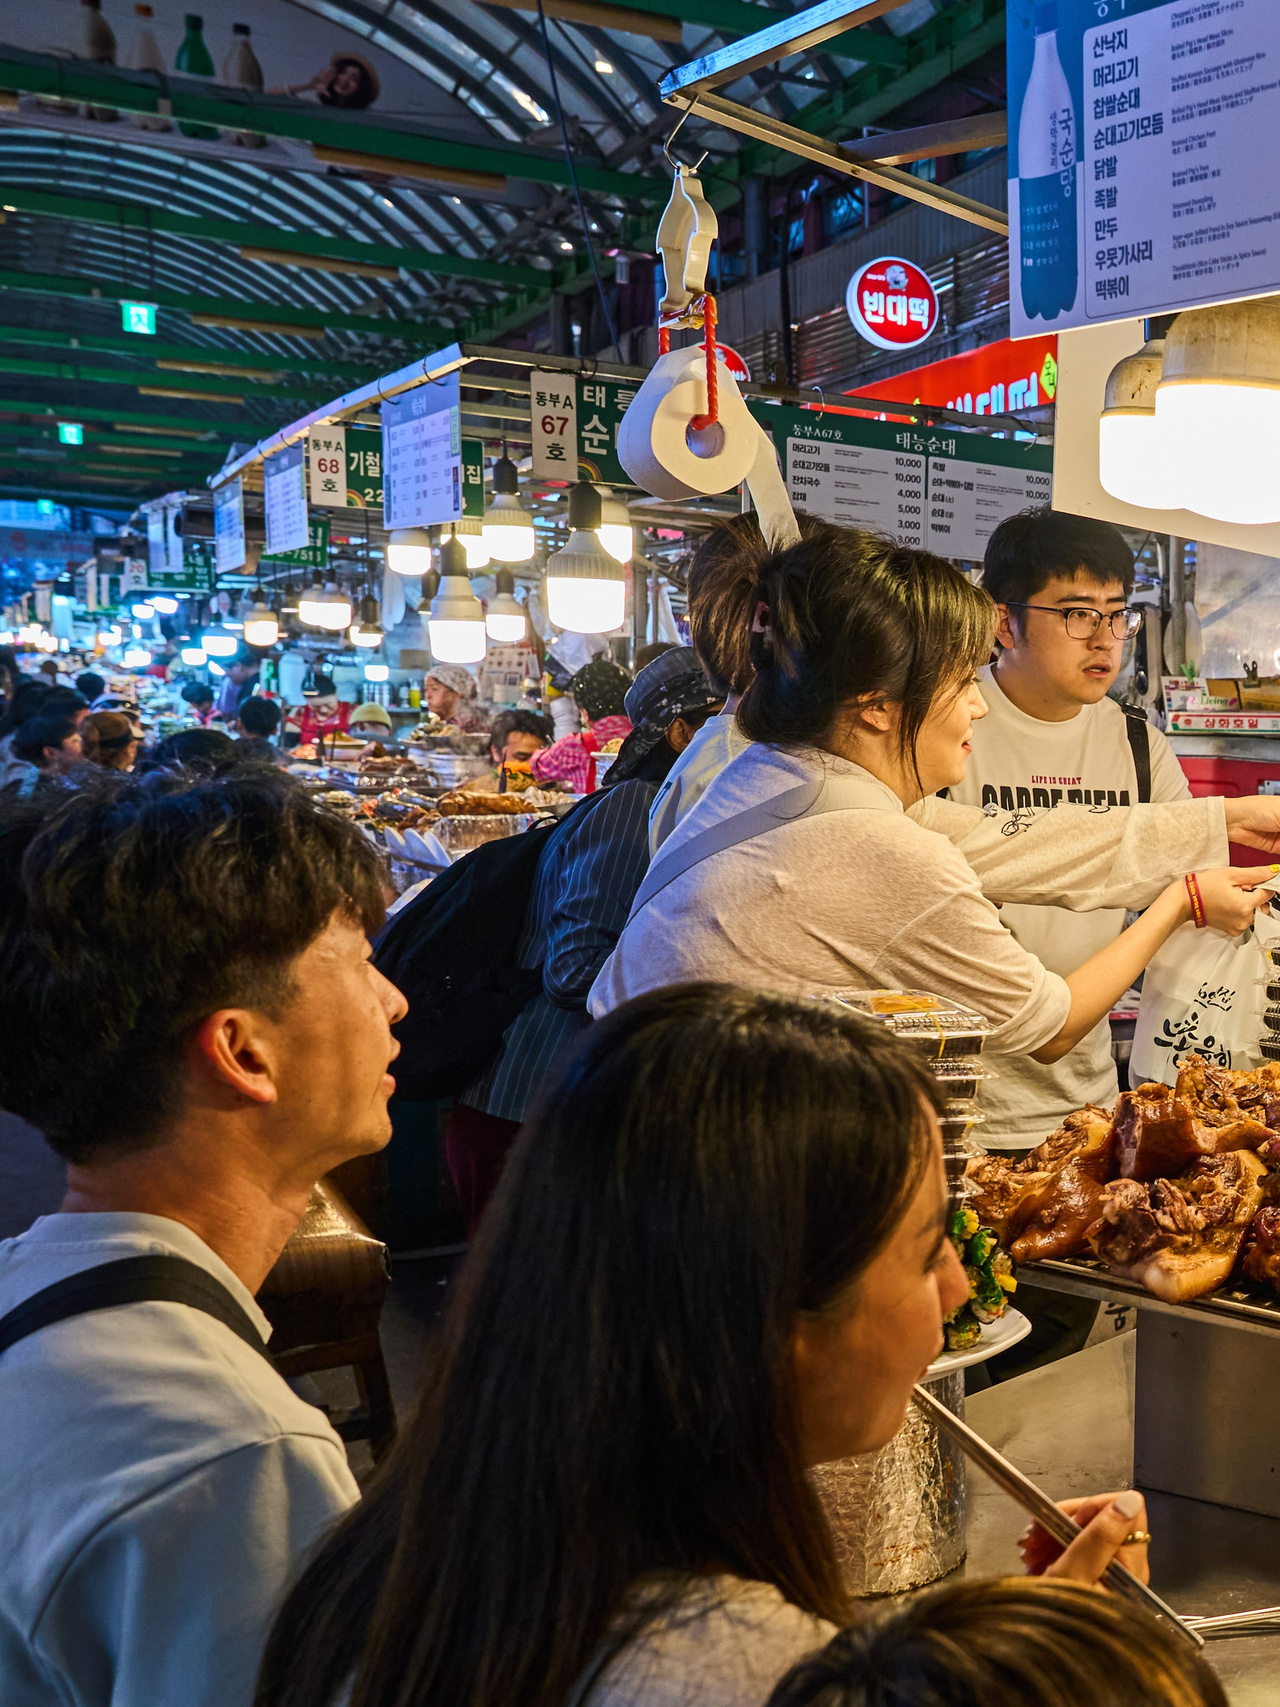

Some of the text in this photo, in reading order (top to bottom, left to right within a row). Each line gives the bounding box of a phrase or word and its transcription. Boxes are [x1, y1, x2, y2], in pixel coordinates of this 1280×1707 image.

[1093, 29, 1128, 58] 산낙지
[1093, 56, 1139, 88] 머리고기
[1093, 87, 1140, 120] 찹쌀순대
[1094, 155, 1118, 181] 닭발
[1094, 186, 1118, 210] 족발
[1095, 217, 1118, 242] 만두
[1095, 239, 1153, 271] 우뭇가사리
[1095, 275, 1129, 301] 떡볶이
[863, 290, 929, 330] 빈대떡
[541, 414, 569, 436] 67
[792, 424, 843, 440] 동부A67호
[546, 443, 567, 462] 호
[792, 443, 820, 455] 머리고기
[318, 458, 340, 474] 68
[350, 451, 382, 478] 기철
[895, 457, 922, 468] 10,000
[321, 478, 339, 493] 호
[792, 475, 820, 487] 잔치국수
[895, 473, 921, 484] 10,000
[1026, 475, 1050, 486] 10,000
[898, 489, 921, 499] 4,000
[1025, 490, 1050, 501] 10,000
[898, 504, 921, 515] 5,000
[898, 520, 921, 530] 3,000
[1204, 718, 1259, 729] 삼화호일
[1032, 775, 1047, 784] LIFE
[1050, 776, 1057, 784] IS
